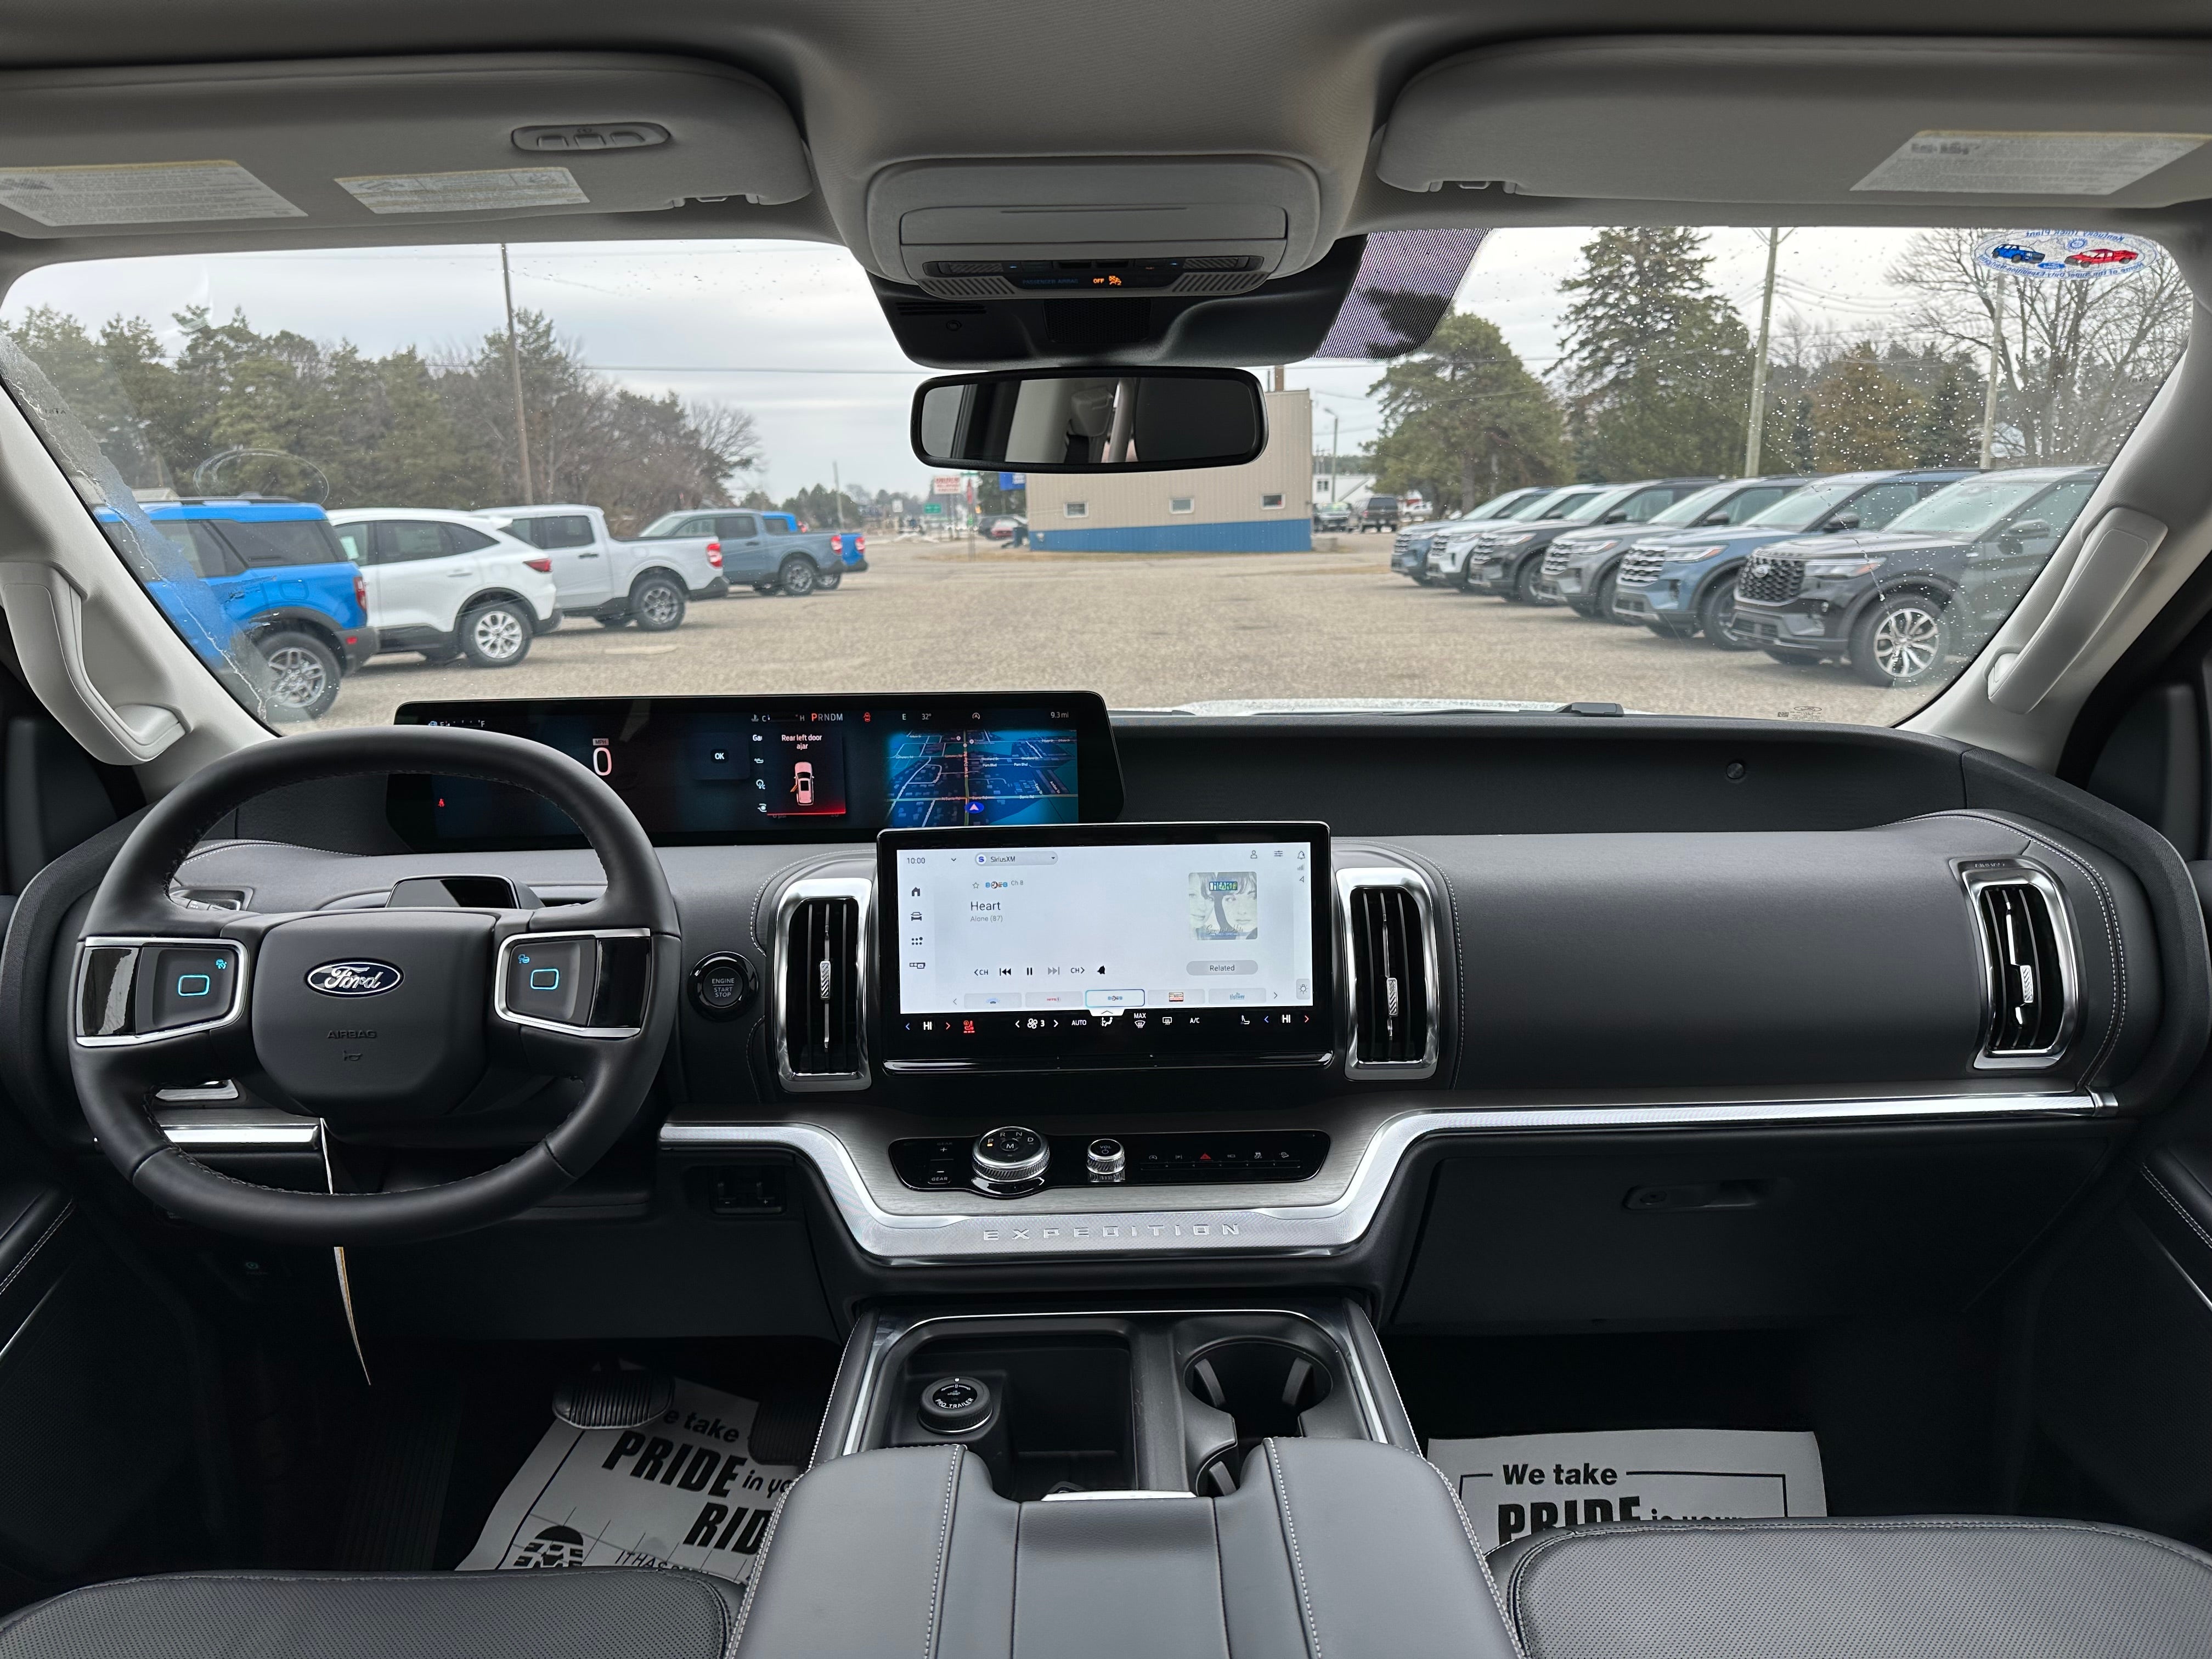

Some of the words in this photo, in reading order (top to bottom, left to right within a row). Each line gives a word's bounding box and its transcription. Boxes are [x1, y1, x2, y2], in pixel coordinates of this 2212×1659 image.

[593, 747, 612, 776] 0
[970, 901, 1001, 911] Heart
[324, 966, 383, 989] Ford
[923, 1021, 932, 1030] HI
[1282, 1015, 1290, 1023] HI
[326, 1029, 377, 1039] AIRBAG
[983, 1223, 1239, 1241] EXPEDITION
[935, 1398, 947, 1407] PRO
[949, 1397, 974, 1408] TRAILER
[682, 1410, 740, 1443] take
[602, 1430, 748, 1498] PRIDE
[742, 1470, 765, 1490] in
[1503, 1464, 1545, 1486] We
[1553, 1463, 1617, 1485] take
